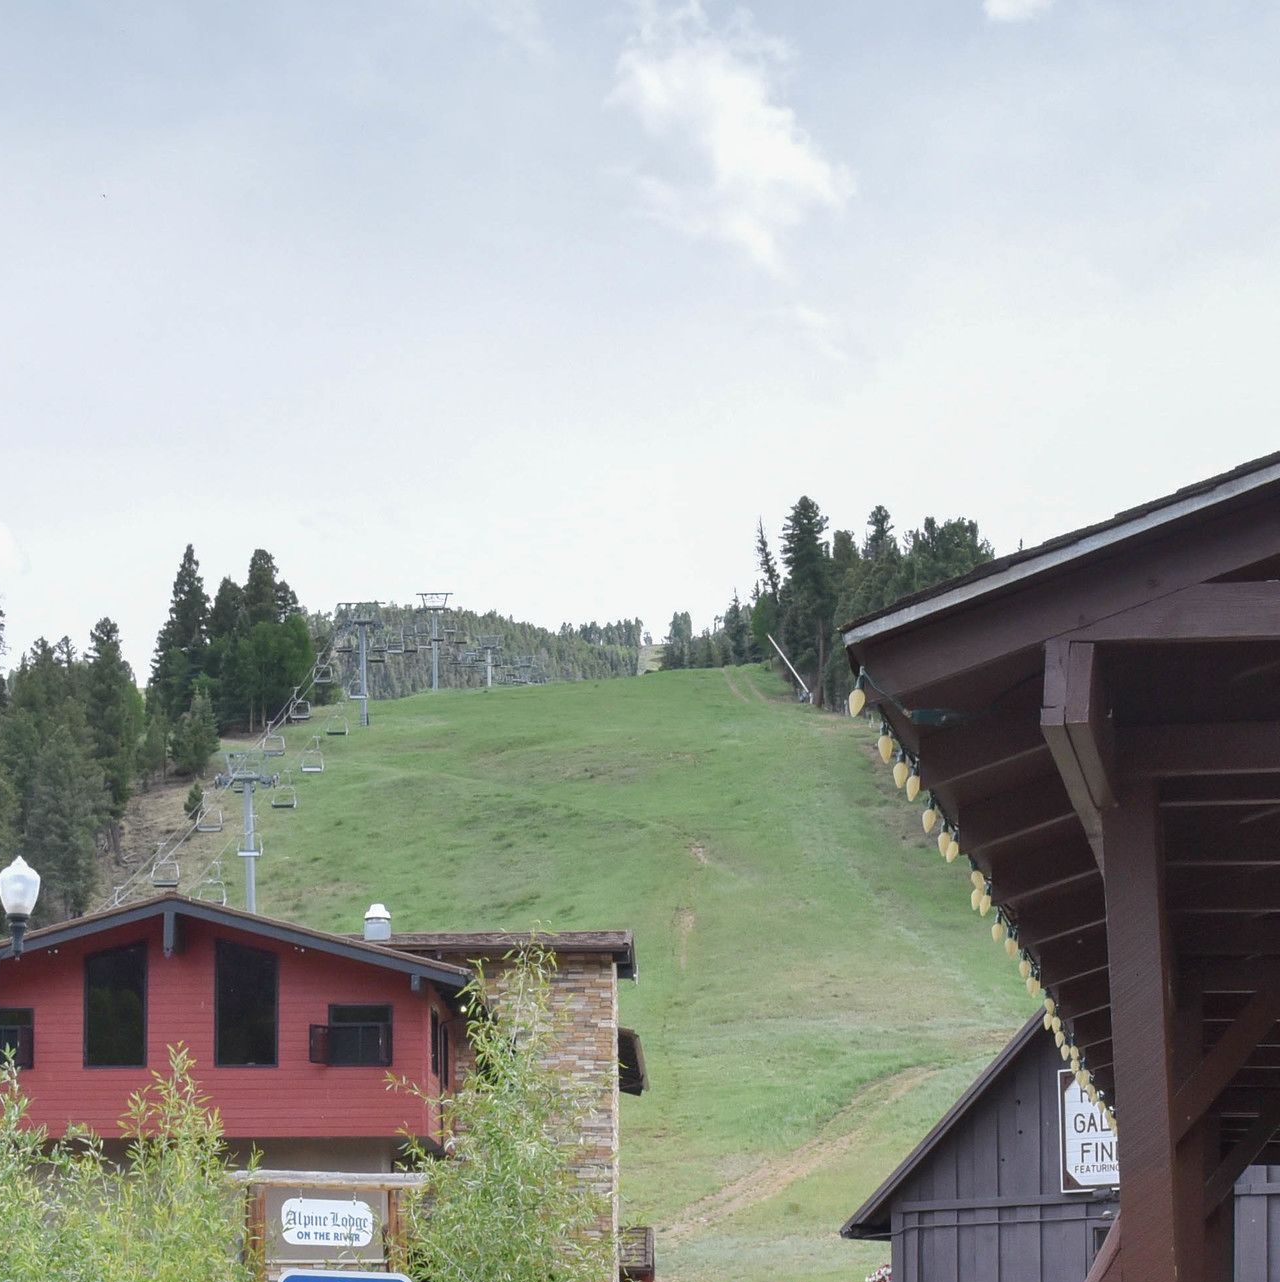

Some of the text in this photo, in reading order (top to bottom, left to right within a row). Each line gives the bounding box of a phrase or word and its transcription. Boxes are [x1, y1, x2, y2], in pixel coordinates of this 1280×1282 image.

[1081, 1141, 1119, 1163] FIN
[286, 1210, 369, 1231] Alpine Lodge
[296, 1231, 311, 1240] ON
[314, 1232, 331, 1241] THE
